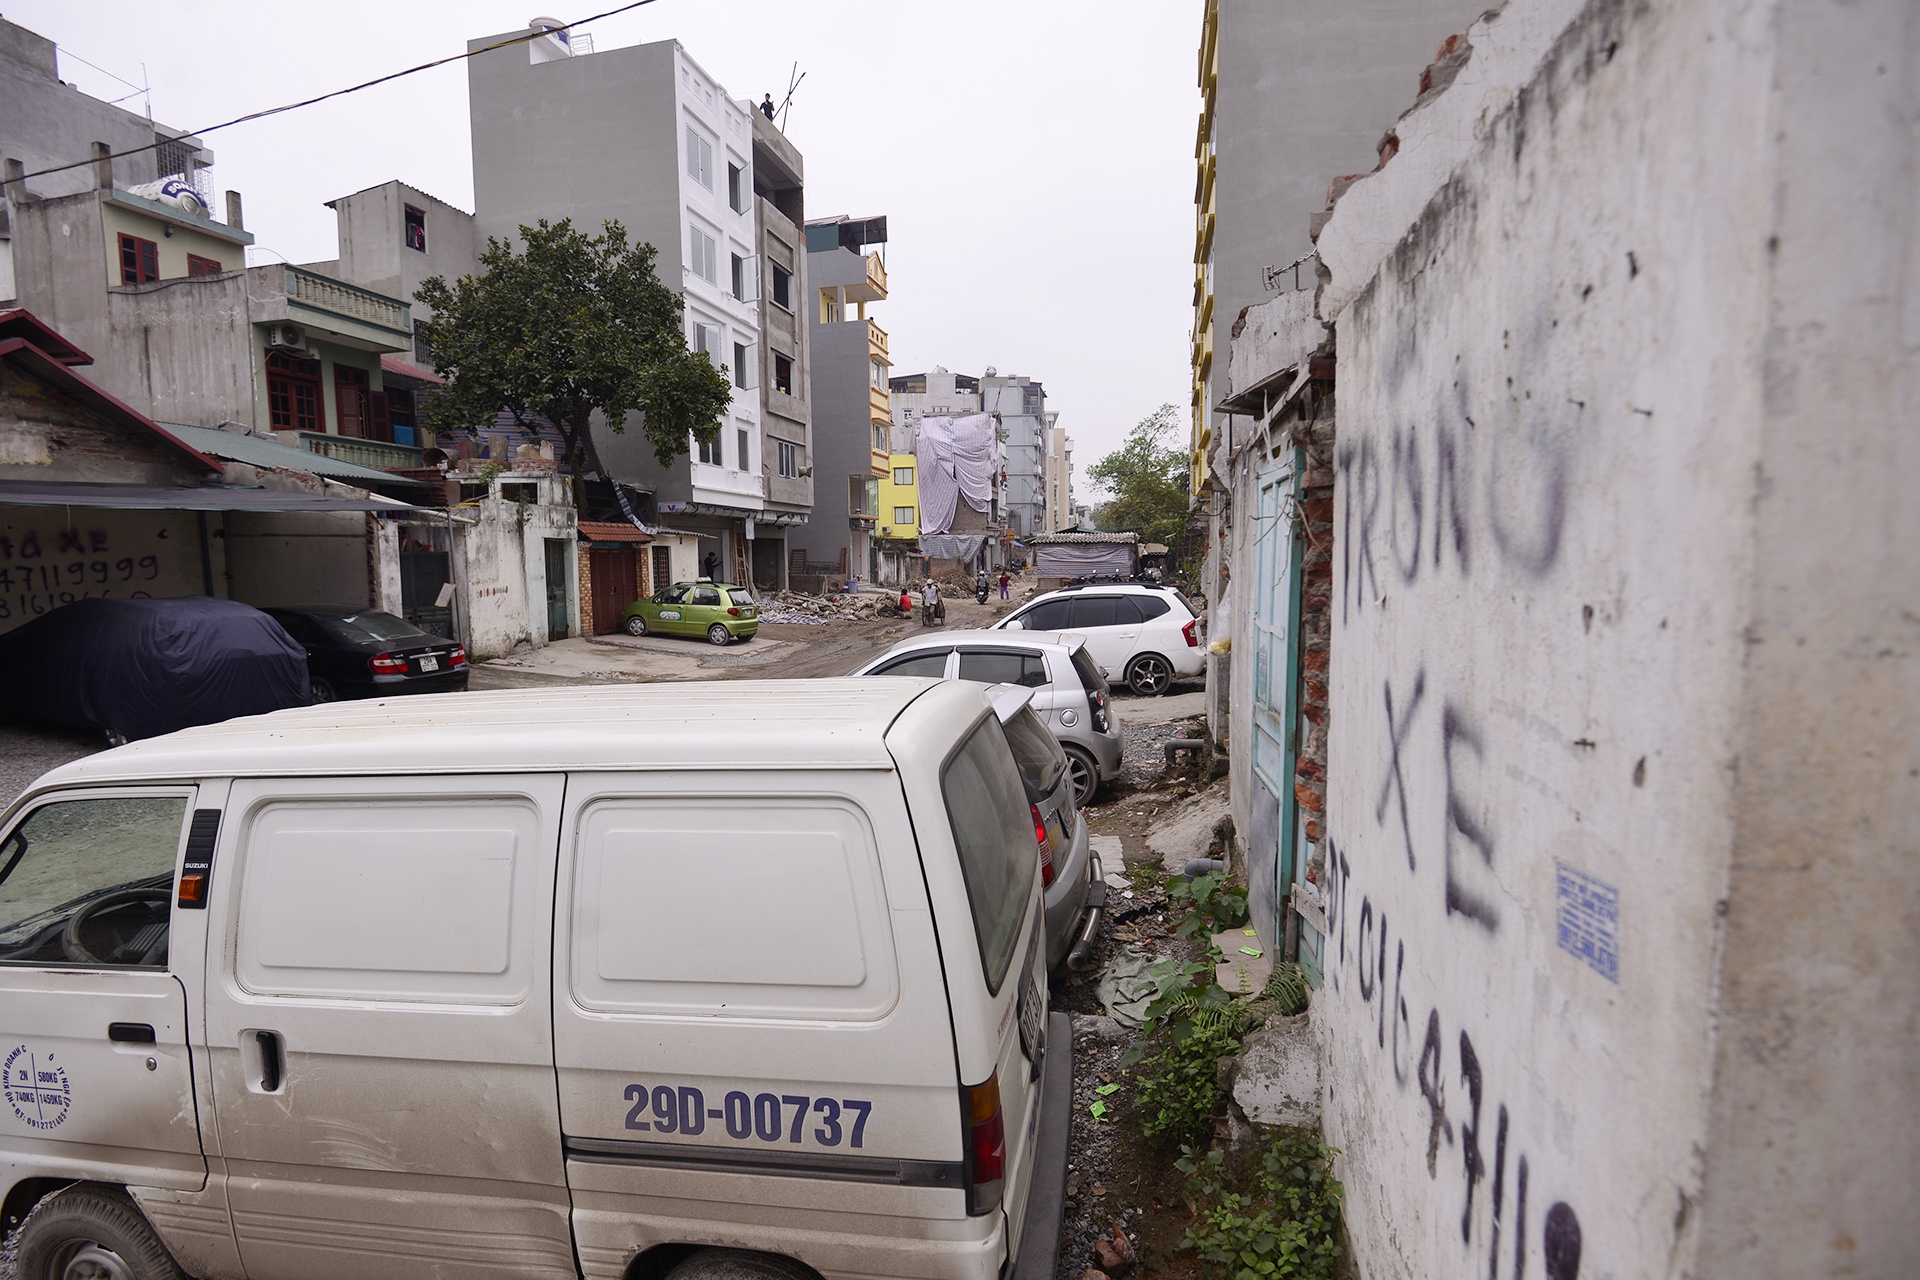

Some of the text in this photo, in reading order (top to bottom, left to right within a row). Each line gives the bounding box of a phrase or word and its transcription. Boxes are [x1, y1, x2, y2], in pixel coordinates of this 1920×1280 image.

[1375, 664, 1499, 937] XE
[19, 1069, 29, 1081] 2N
[38, 1071, 58, 1083] 580KG
[15, 1091, 35, 1103] 740KG
[623, 1083, 872, 1149] 29D-00737
